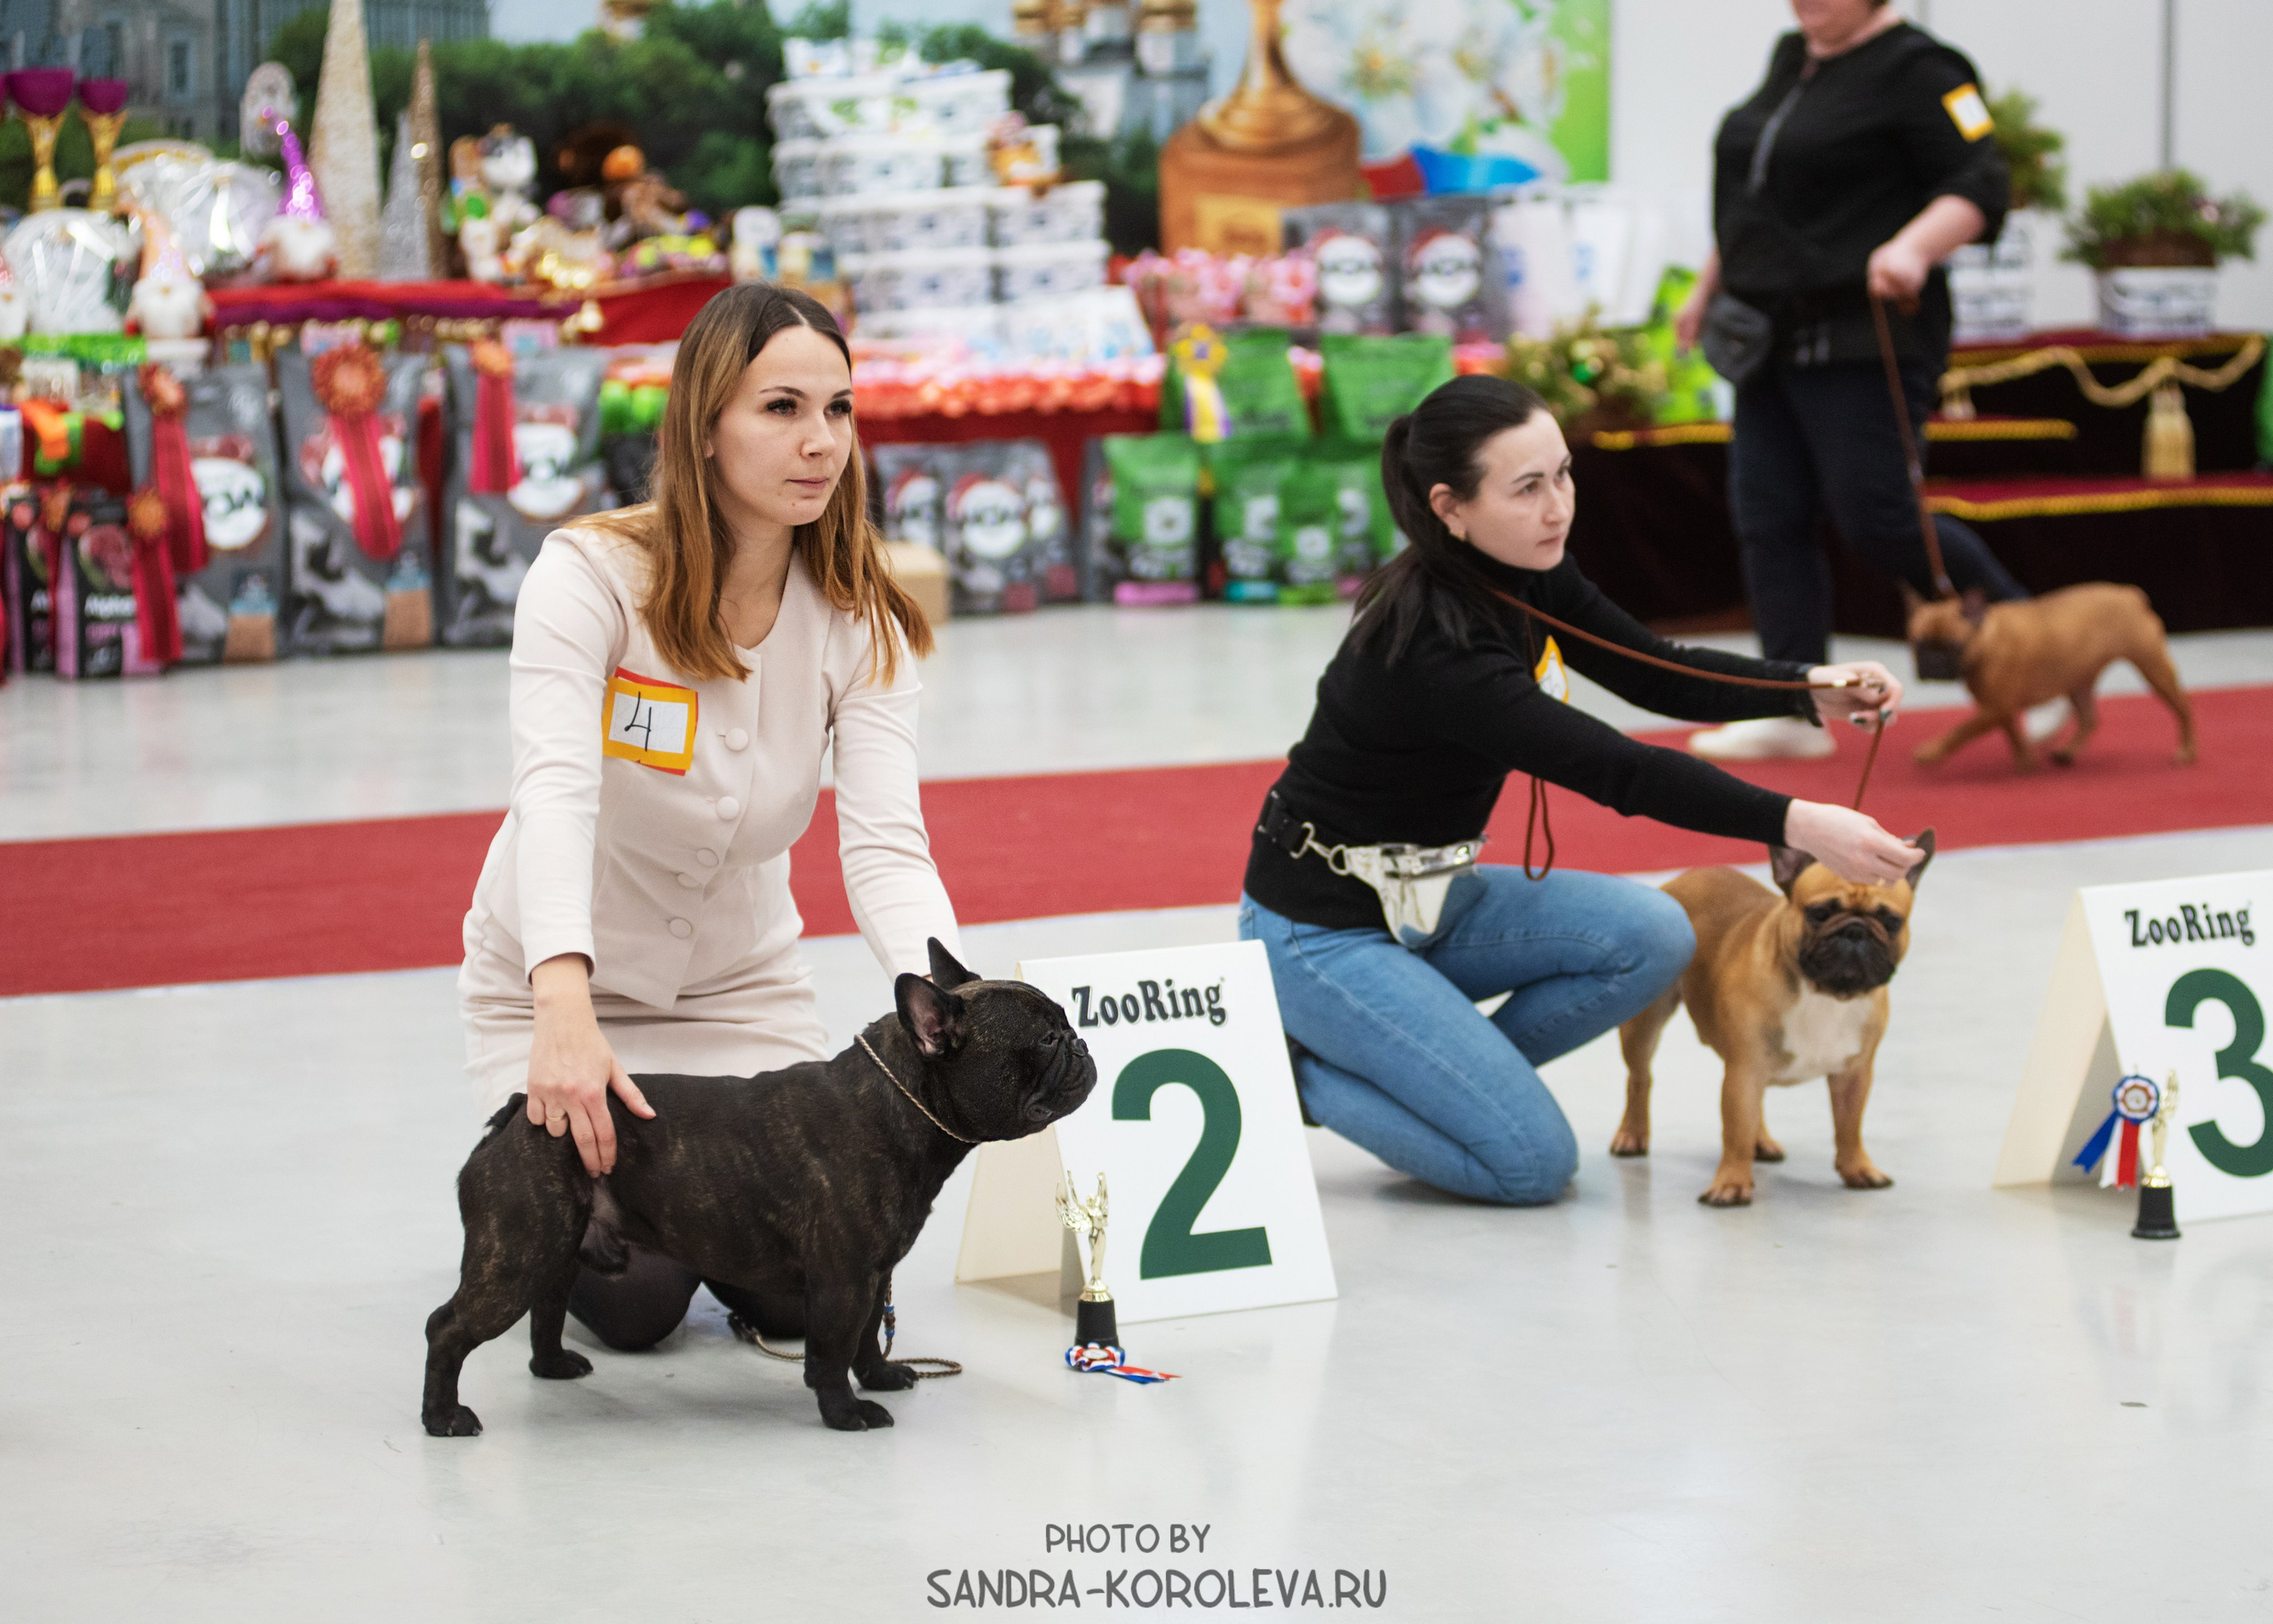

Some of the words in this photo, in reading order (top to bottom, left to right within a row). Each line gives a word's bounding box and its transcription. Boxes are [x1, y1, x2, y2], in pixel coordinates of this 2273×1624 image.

[624, 691, 652, 752] 4
[2125, 903, 2255, 947] ZooRing
[1072, 978, 1225, 1027] ZooRing
[2165, 968, 2273, 1179] 3
[1112, 1048, 1273, 1280] 2
